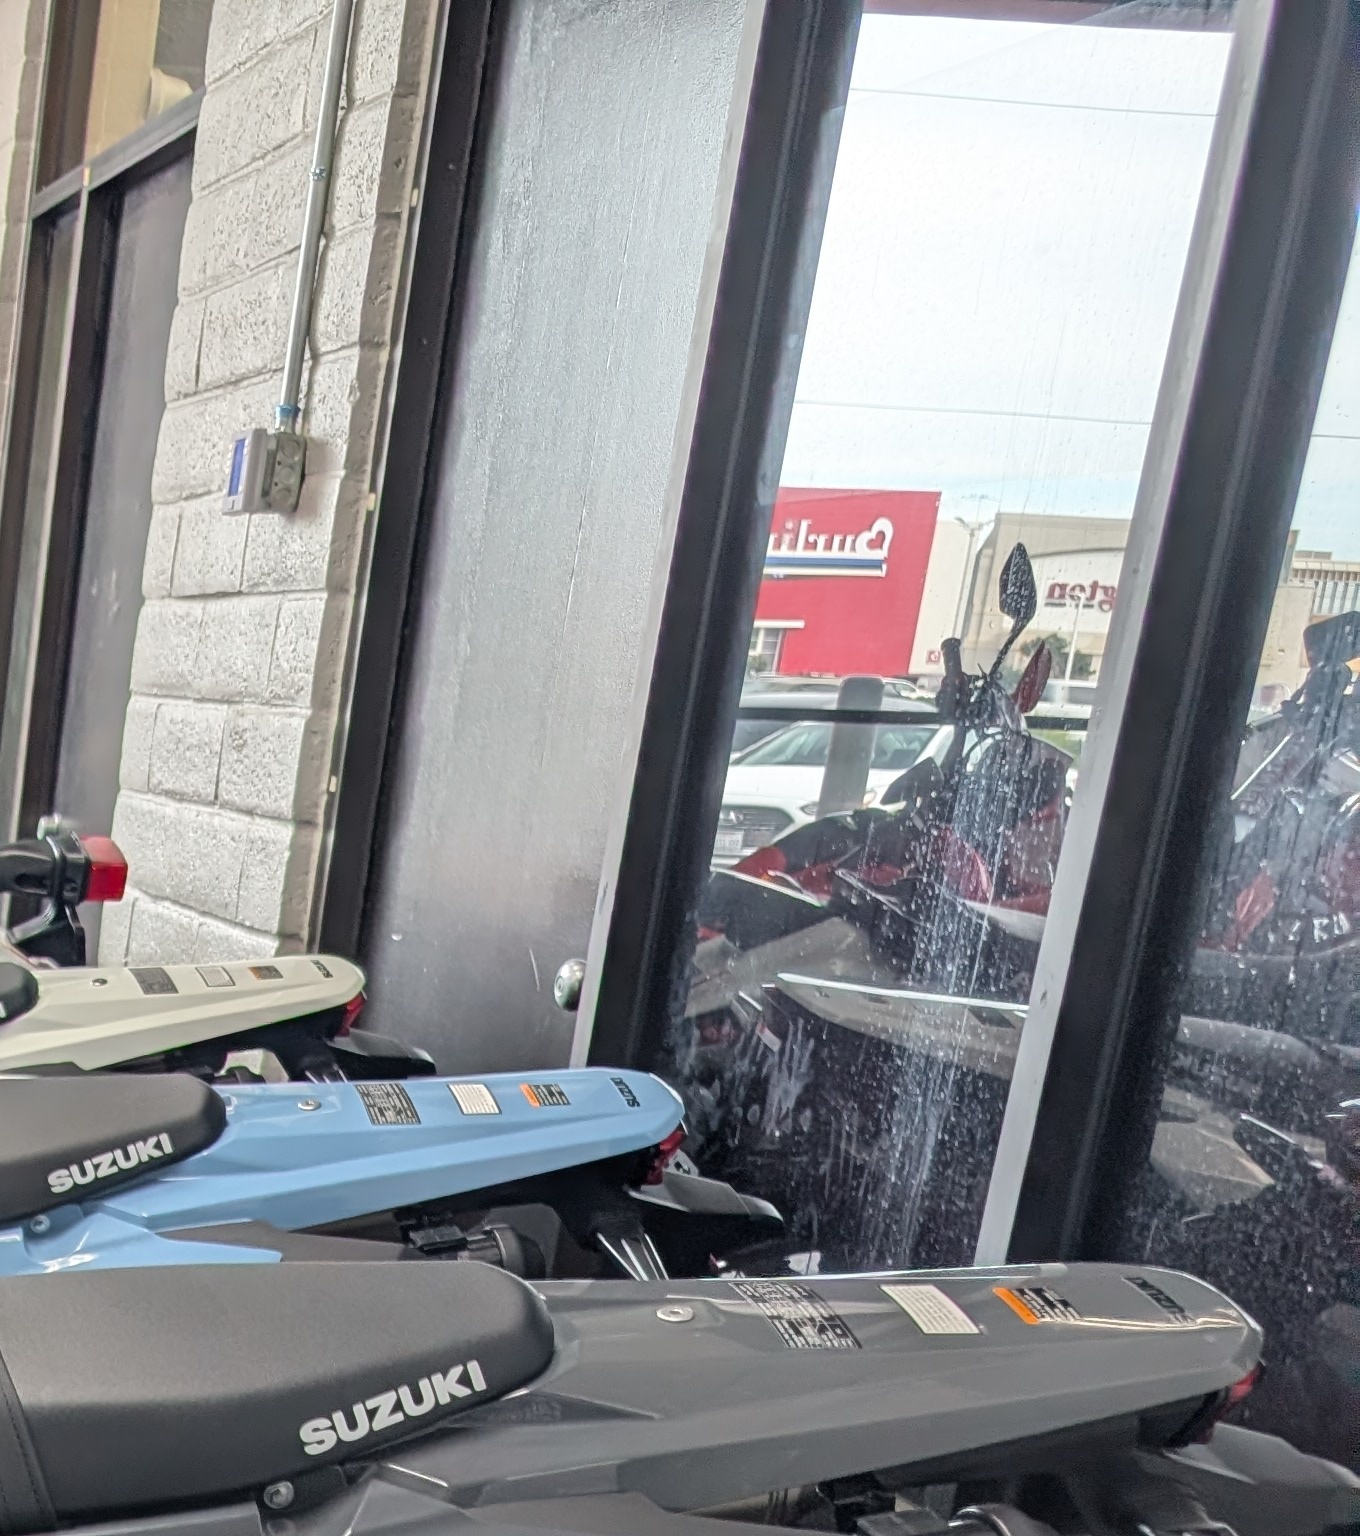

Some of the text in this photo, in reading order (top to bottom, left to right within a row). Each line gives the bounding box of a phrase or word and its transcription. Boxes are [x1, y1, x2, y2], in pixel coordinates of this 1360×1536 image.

[609, 1076, 641, 1109] SUZUKI
[47, 1133, 174, 1194] SUZUKI
[298, 1359, 487, 1456] SUZUKI
